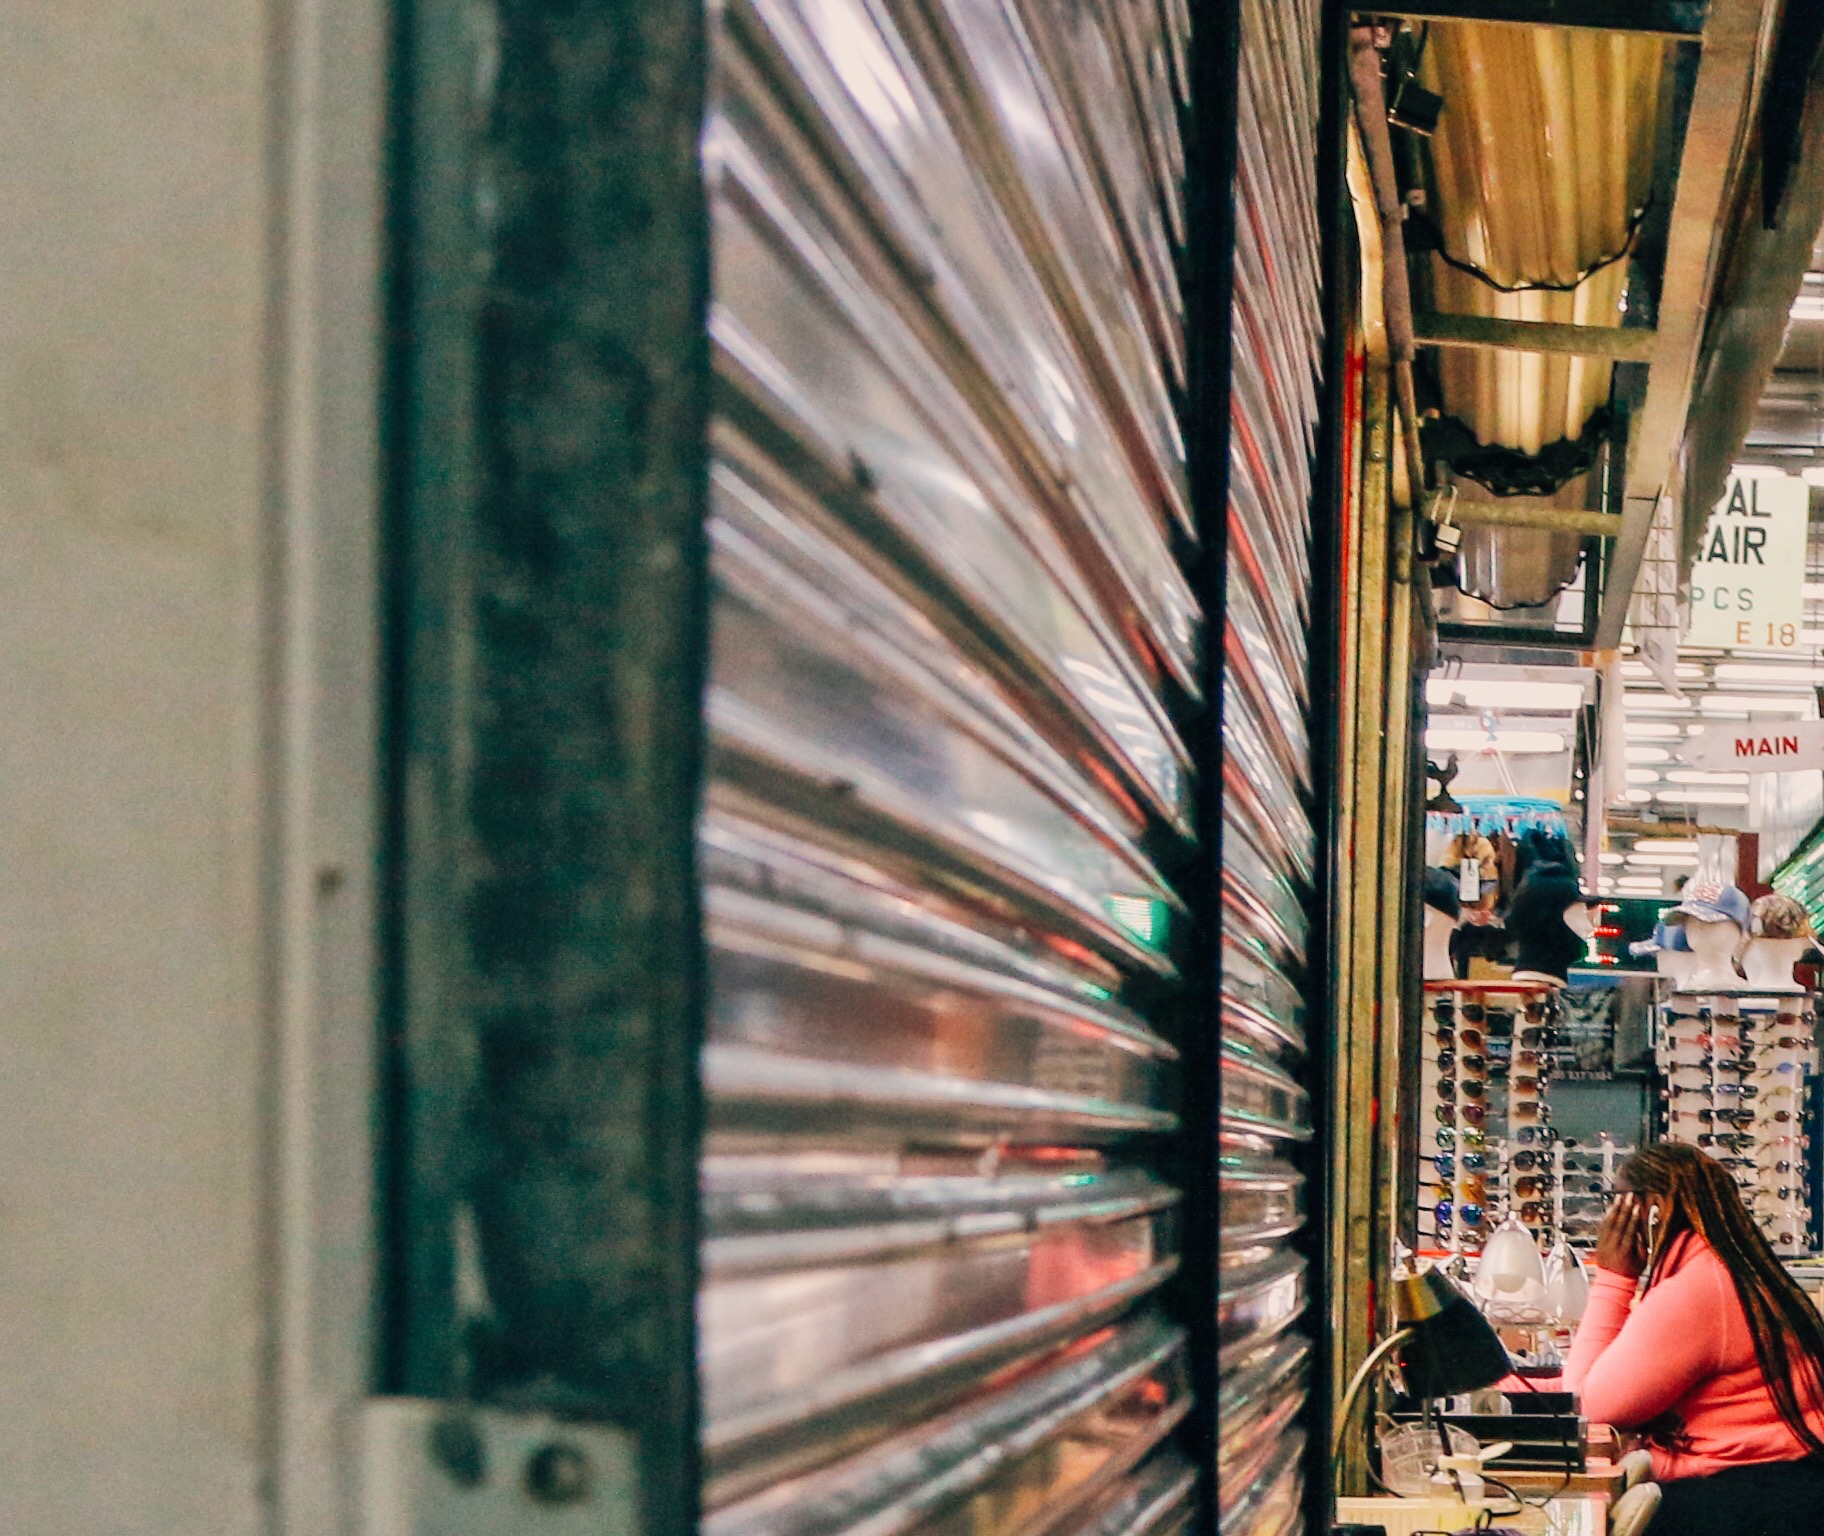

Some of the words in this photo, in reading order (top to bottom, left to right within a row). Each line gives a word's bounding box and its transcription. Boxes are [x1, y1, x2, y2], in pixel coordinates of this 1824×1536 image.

[1698, 525, 1766, 564] AIR
[1736, 621, 1751, 644] E
[1766, 622, 1796, 647] 18
[1735, 736, 1799, 757] MAIN
